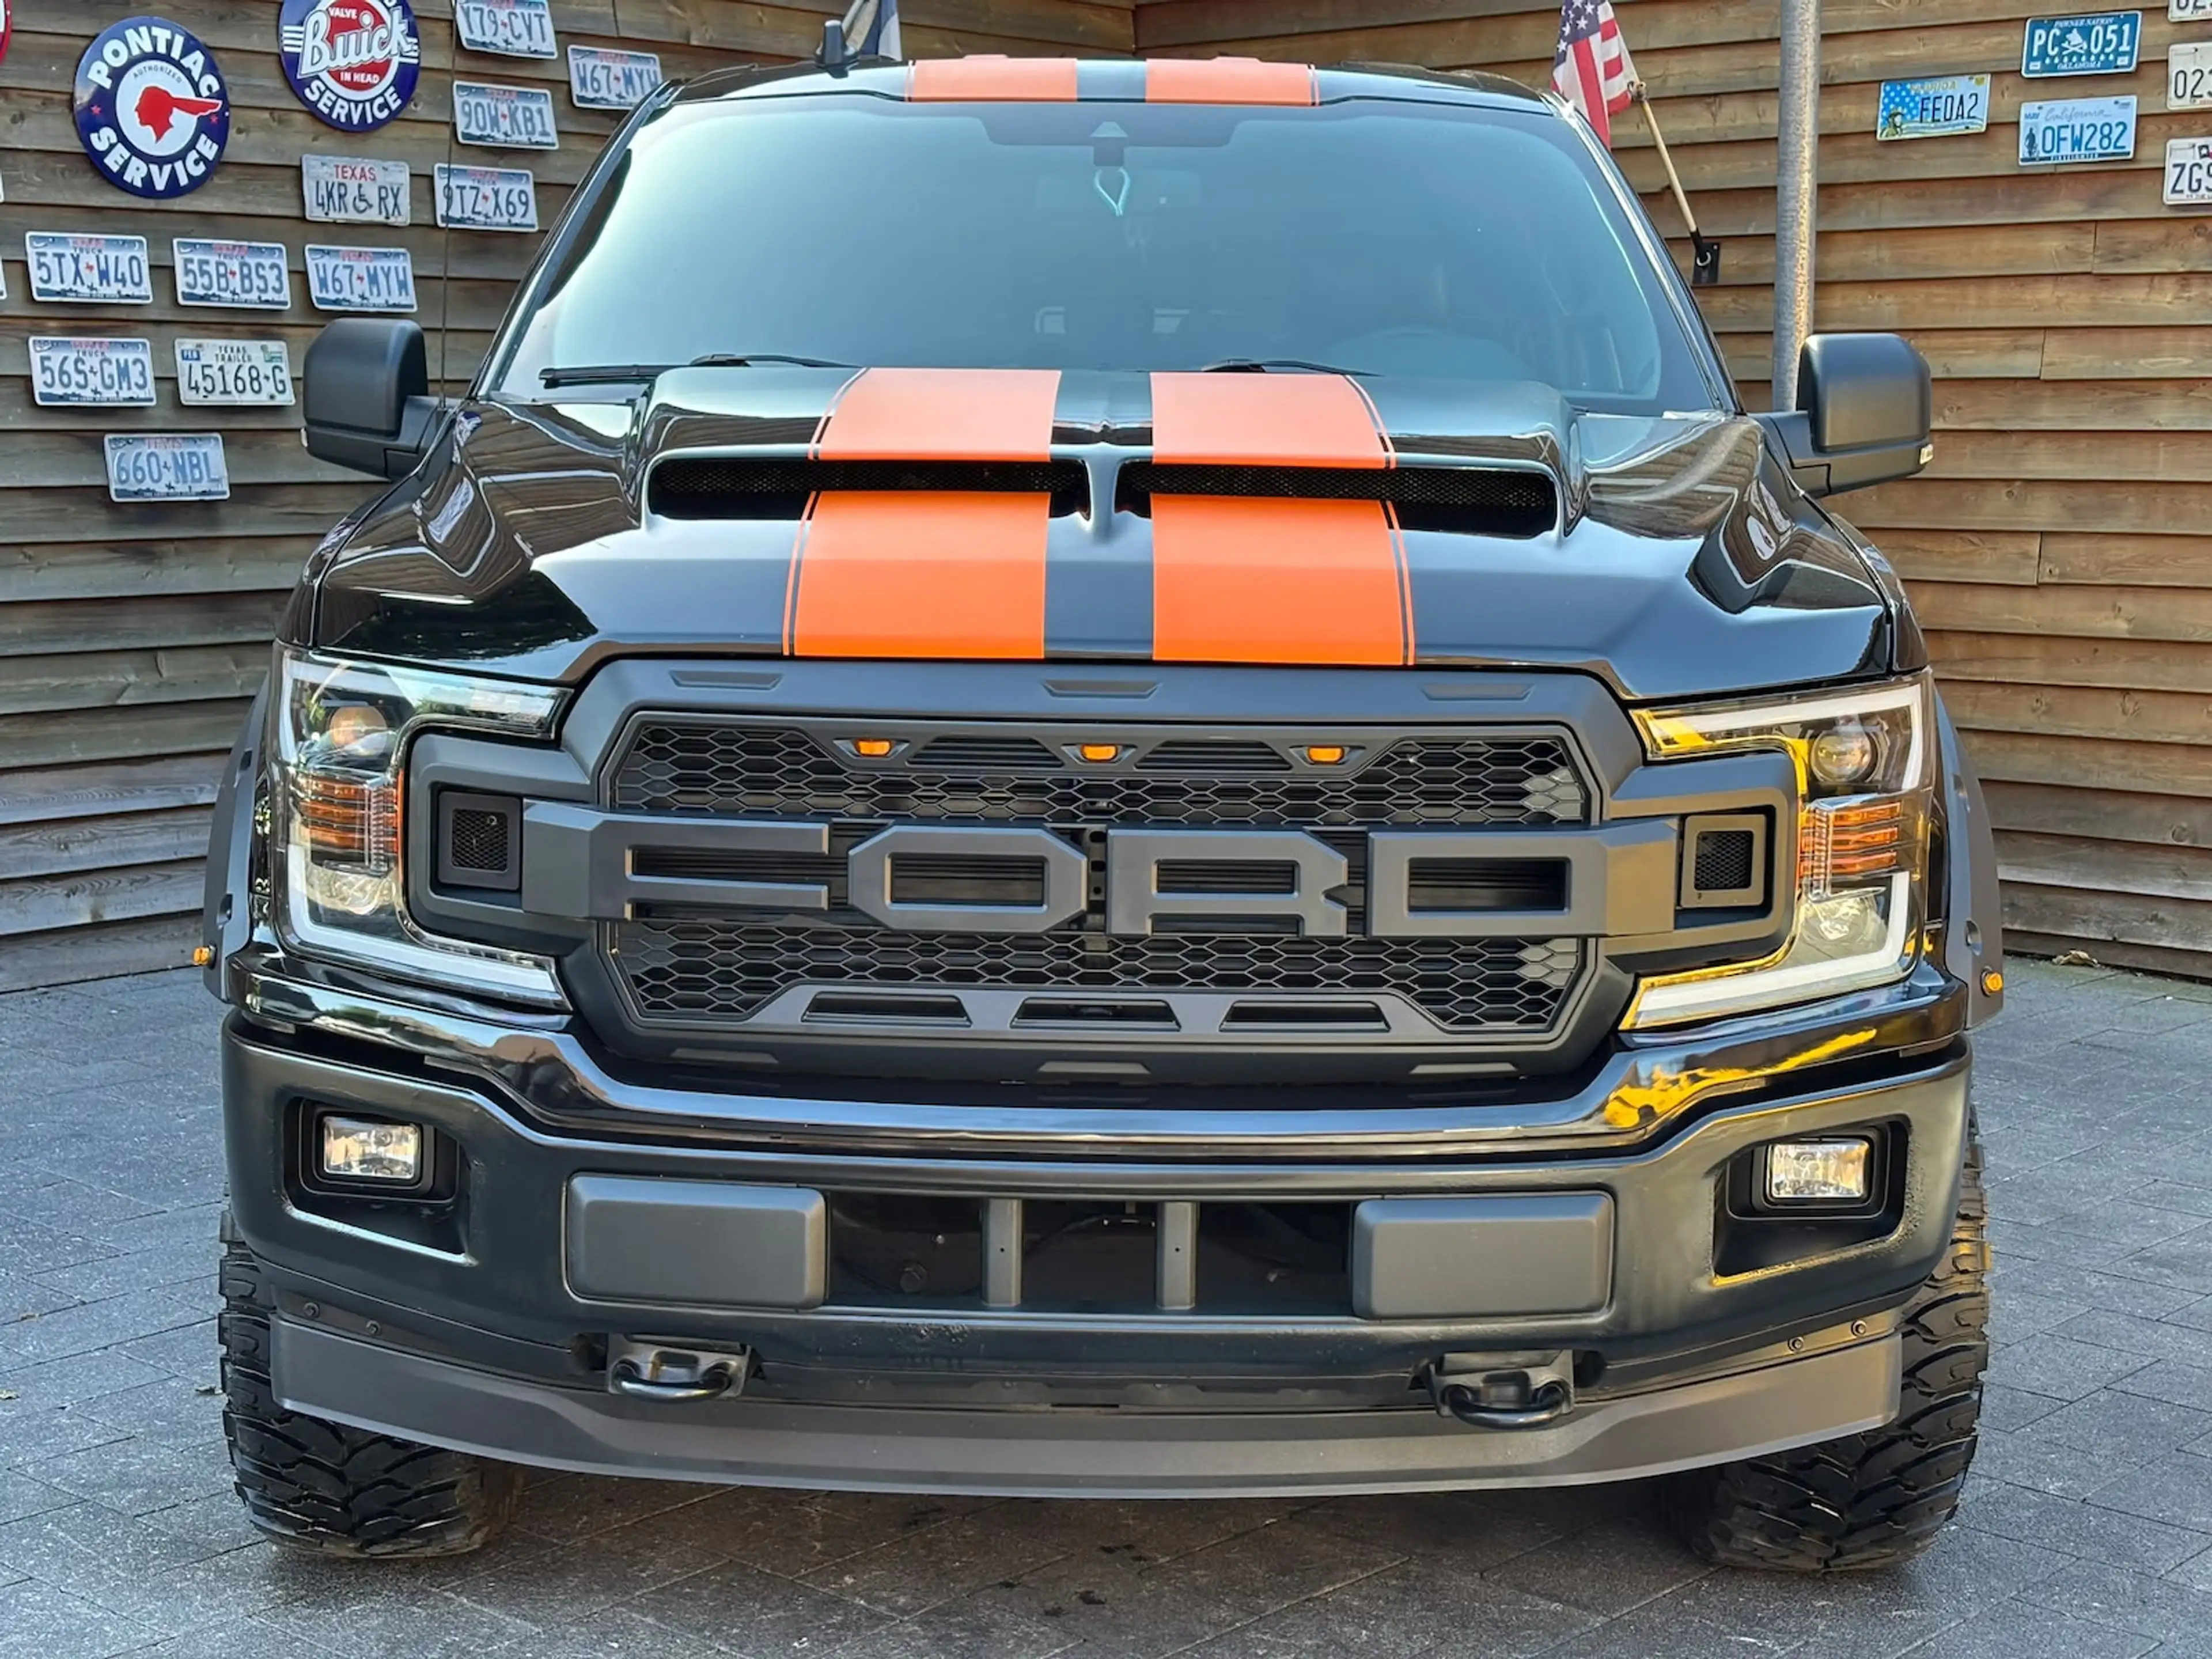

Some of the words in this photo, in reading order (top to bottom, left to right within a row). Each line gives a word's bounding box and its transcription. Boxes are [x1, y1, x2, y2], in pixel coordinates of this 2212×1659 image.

[328, 7, 358, 20] VALVE
[508, 12, 547, 43] CVT
[296, 5, 412, 79] Buick
[2032, 28, 2060, 57] PC
[2090, 24, 2131, 54] 051
[87, 25, 221, 97] PONTIAC
[132, 64, 183, 84] AUTHORIZED
[340, 71, 350, 81] IN
[354, 72, 380, 84] HEAD
[575, 63, 612, 94] W67
[304, 80, 402, 126] SERVICE
[507, 105, 551, 138] KB1
[89, 126, 219, 191] SERVICE
[334, 164, 377, 181] TEXAS
[315, 180, 348, 213] 4KR
[378, 184, 402, 217] RX
[442, 184, 482, 215] 9TZ
[492, 187, 530, 218] X69
[35, 251, 85, 286] 5TX
[183, 257, 229, 292] 55B
[238, 261, 284, 294] BS3
[215, 353, 253, 362] TRAILER
[218, 346, 248, 354] TEXAS
[39, 355, 89, 389] 56S
[99, 357, 148, 391] GM3
[187, 363, 264, 395] 45168
[272, 365, 287, 395] G
[116, 450, 163, 485] 660
[172, 450, 221, 484] NBL
[589, 813, 1609, 938] FORD
